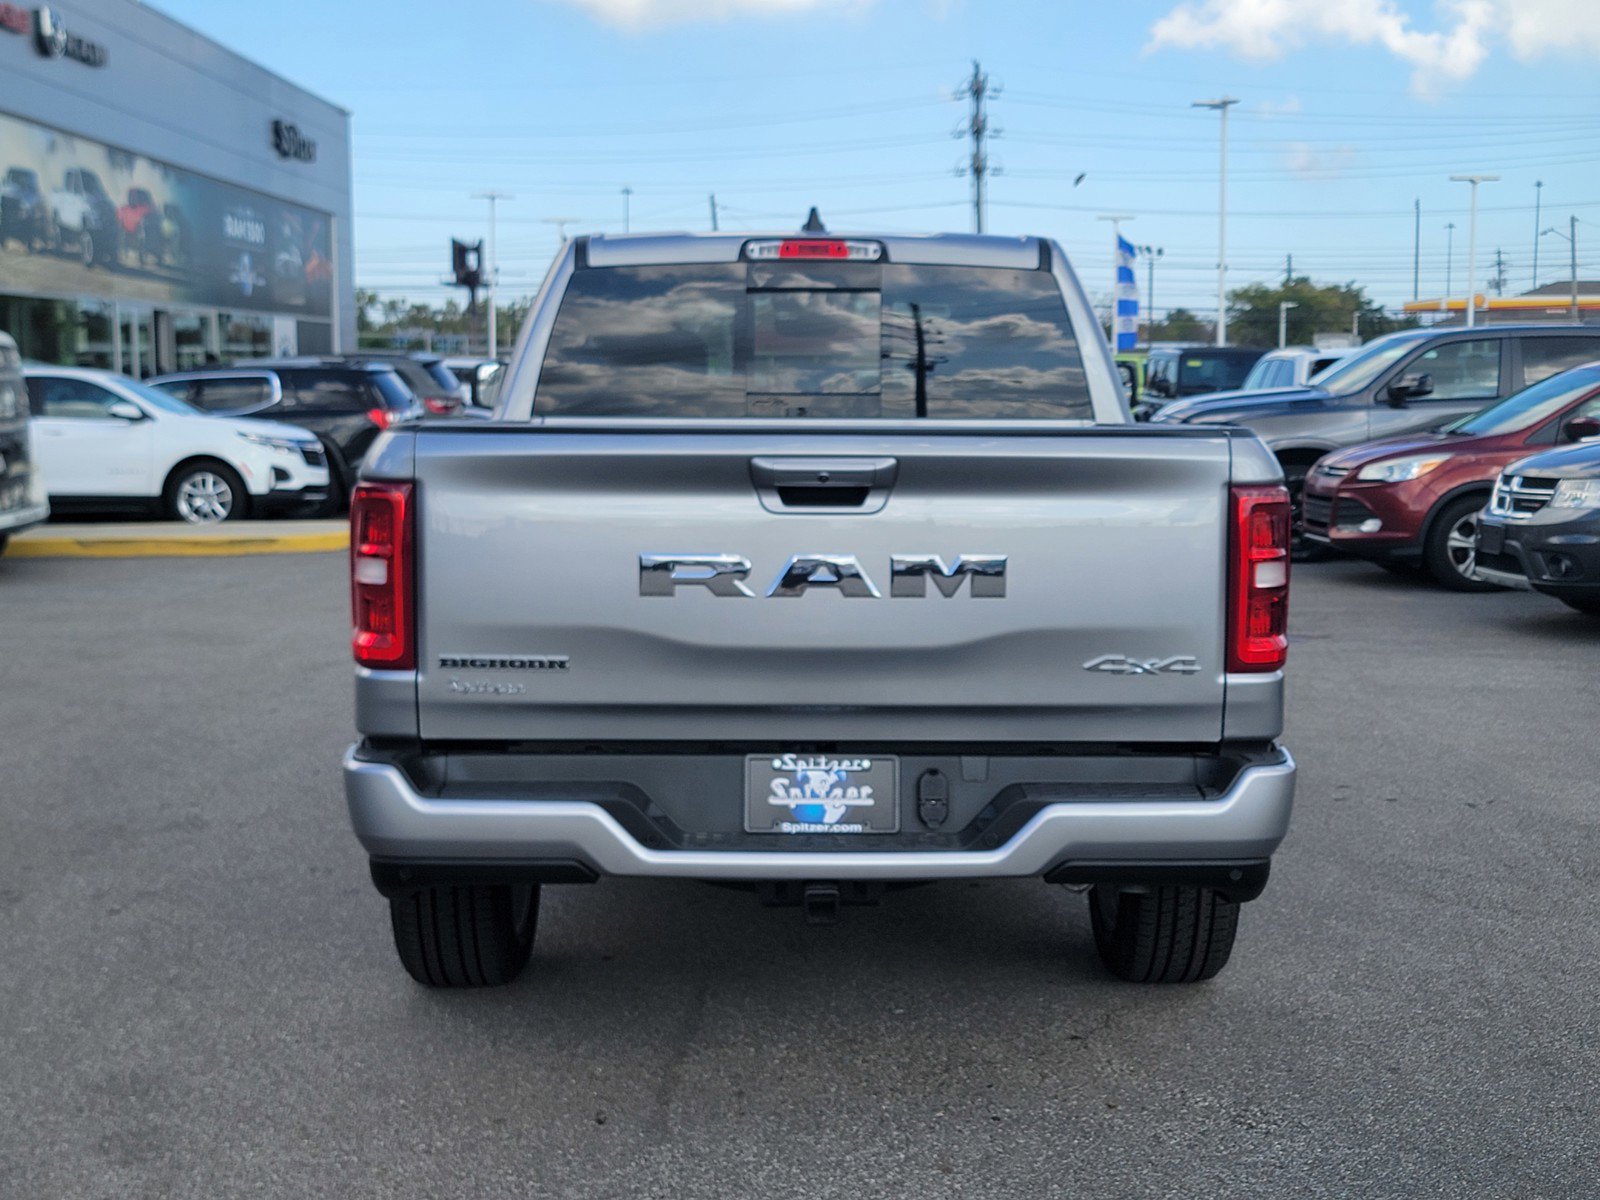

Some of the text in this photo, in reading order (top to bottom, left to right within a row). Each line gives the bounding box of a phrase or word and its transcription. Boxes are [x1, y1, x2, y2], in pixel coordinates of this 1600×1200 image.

[639, 553, 1008, 598] RAM
[781, 753, 863, 774] Spitzer
[781, 822, 862, 834] Spitzer.com
